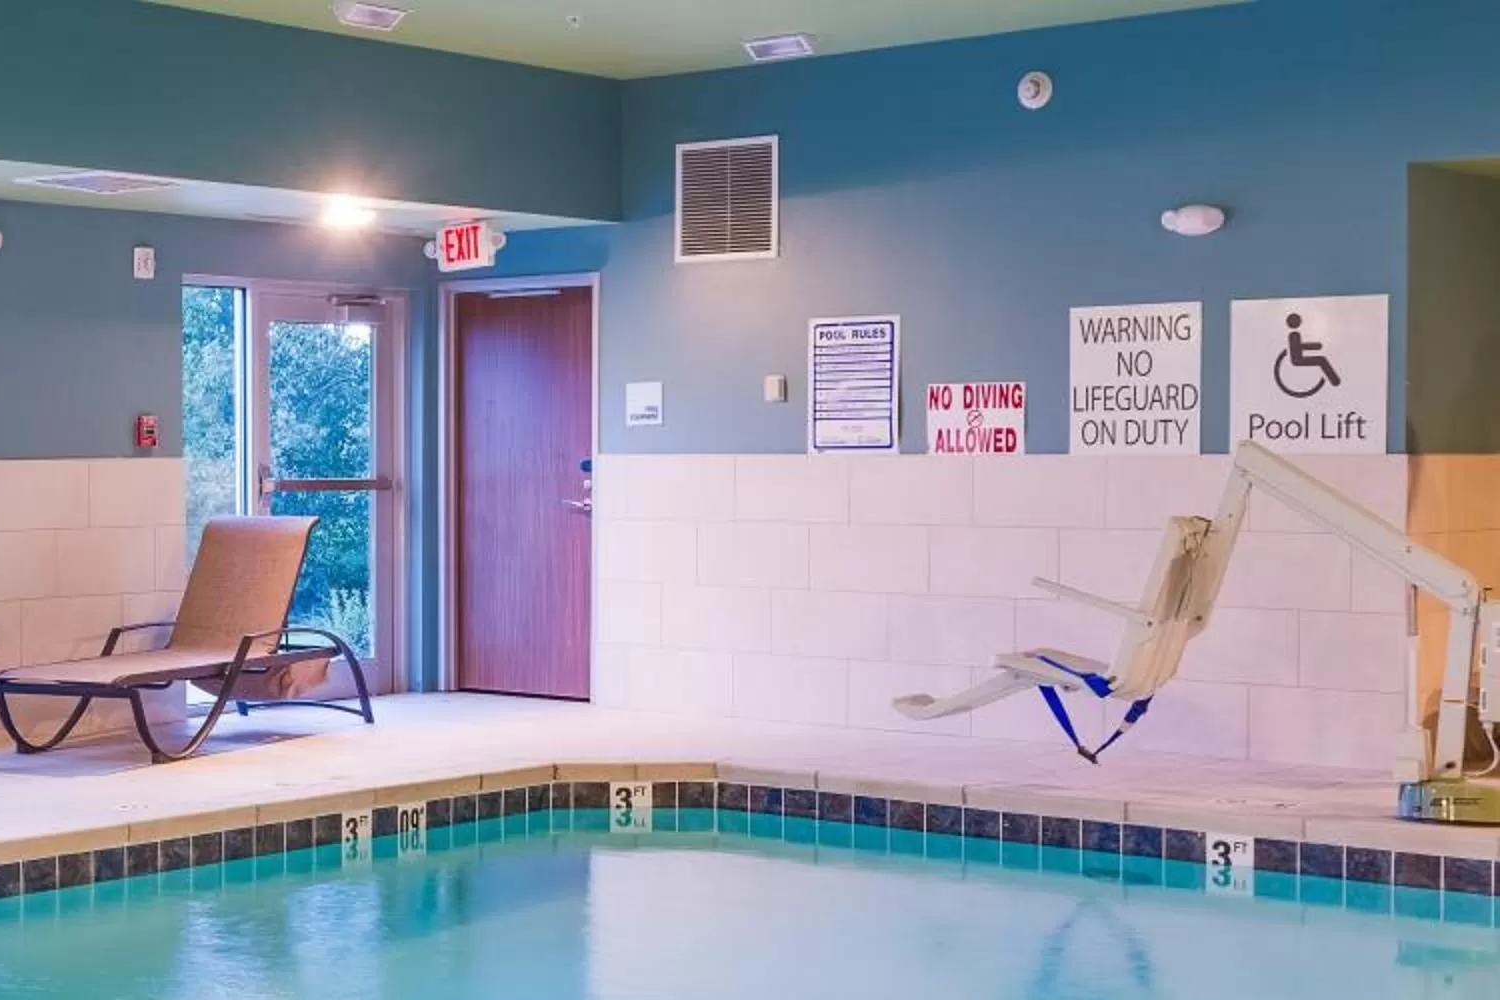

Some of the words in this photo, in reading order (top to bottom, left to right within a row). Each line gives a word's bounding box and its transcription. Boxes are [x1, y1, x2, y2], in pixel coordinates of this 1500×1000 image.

[445, 225, 481, 262] EXIT
[851, 328, 887, 339] RULES
[1079, 313, 1192, 344] WARNING
[1117, 349, 1153, 377] NO
[929, 385, 952, 410] NO
[963, 383, 1023, 409] DIVING
[1073, 383, 1199, 412] LIFEGUARD
[1081, 419, 1117, 446] ON
[1125, 418, 1189, 445] DUTY
[1249, 411, 1309, 440] Pool
[1320, 411, 1367, 439] Lift
[935, 427, 1018, 454] ALLOWED
